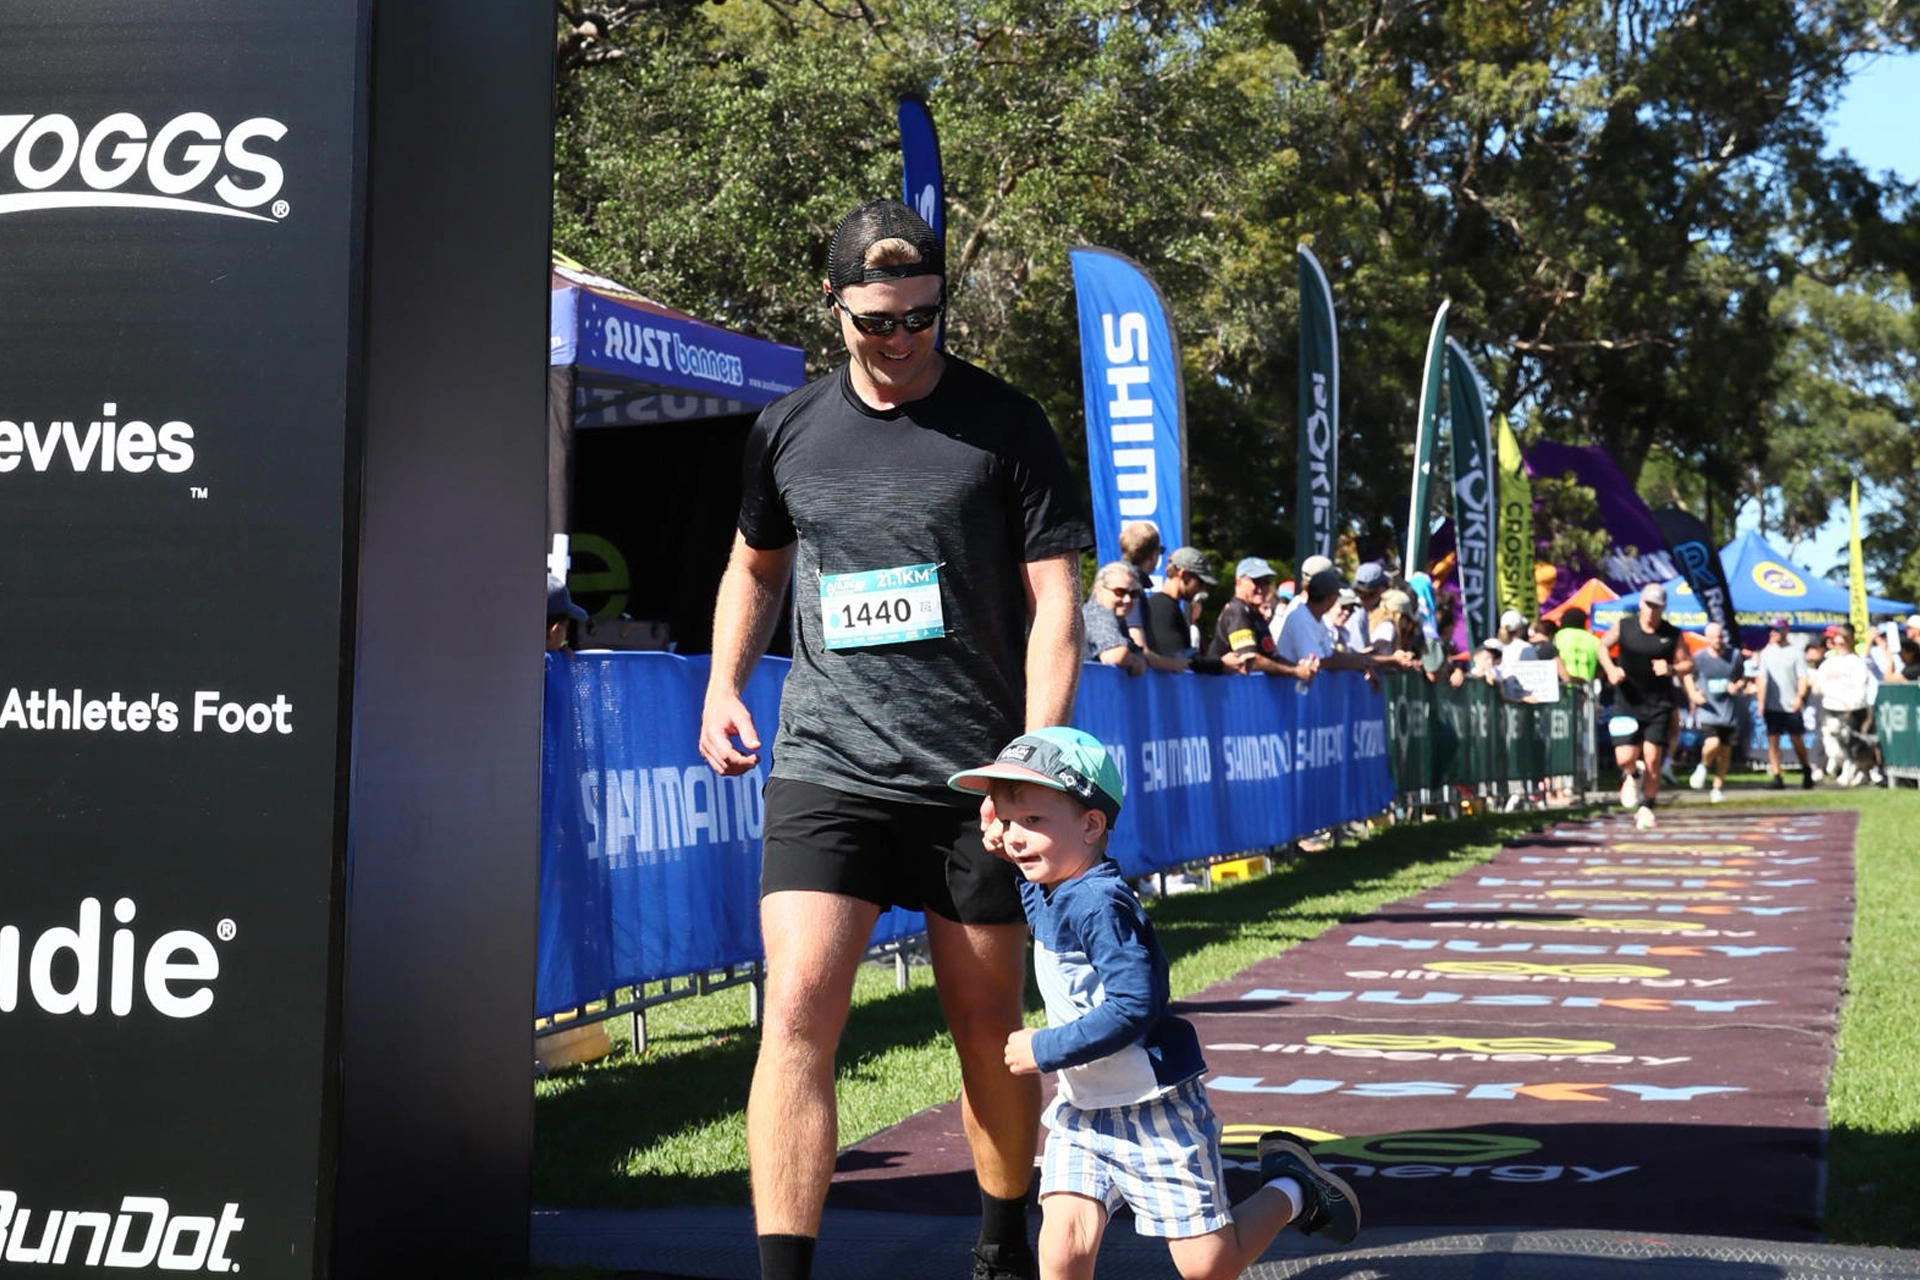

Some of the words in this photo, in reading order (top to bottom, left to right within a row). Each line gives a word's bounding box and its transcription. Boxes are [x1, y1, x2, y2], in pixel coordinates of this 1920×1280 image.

[1102, 312, 1164, 592] SHIM
[1502, 502, 1523, 612] CROSSIN
[876, 568, 930, 588] 21.1KM
[842, 598, 911, 628] 1440
[0, 687, 180, 733] Athlete's
[193, 690, 293, 734] Foot
[1240, 988, 1776, 1011] HUSKY
[1205, 1075, 1749, 1102] USKY
